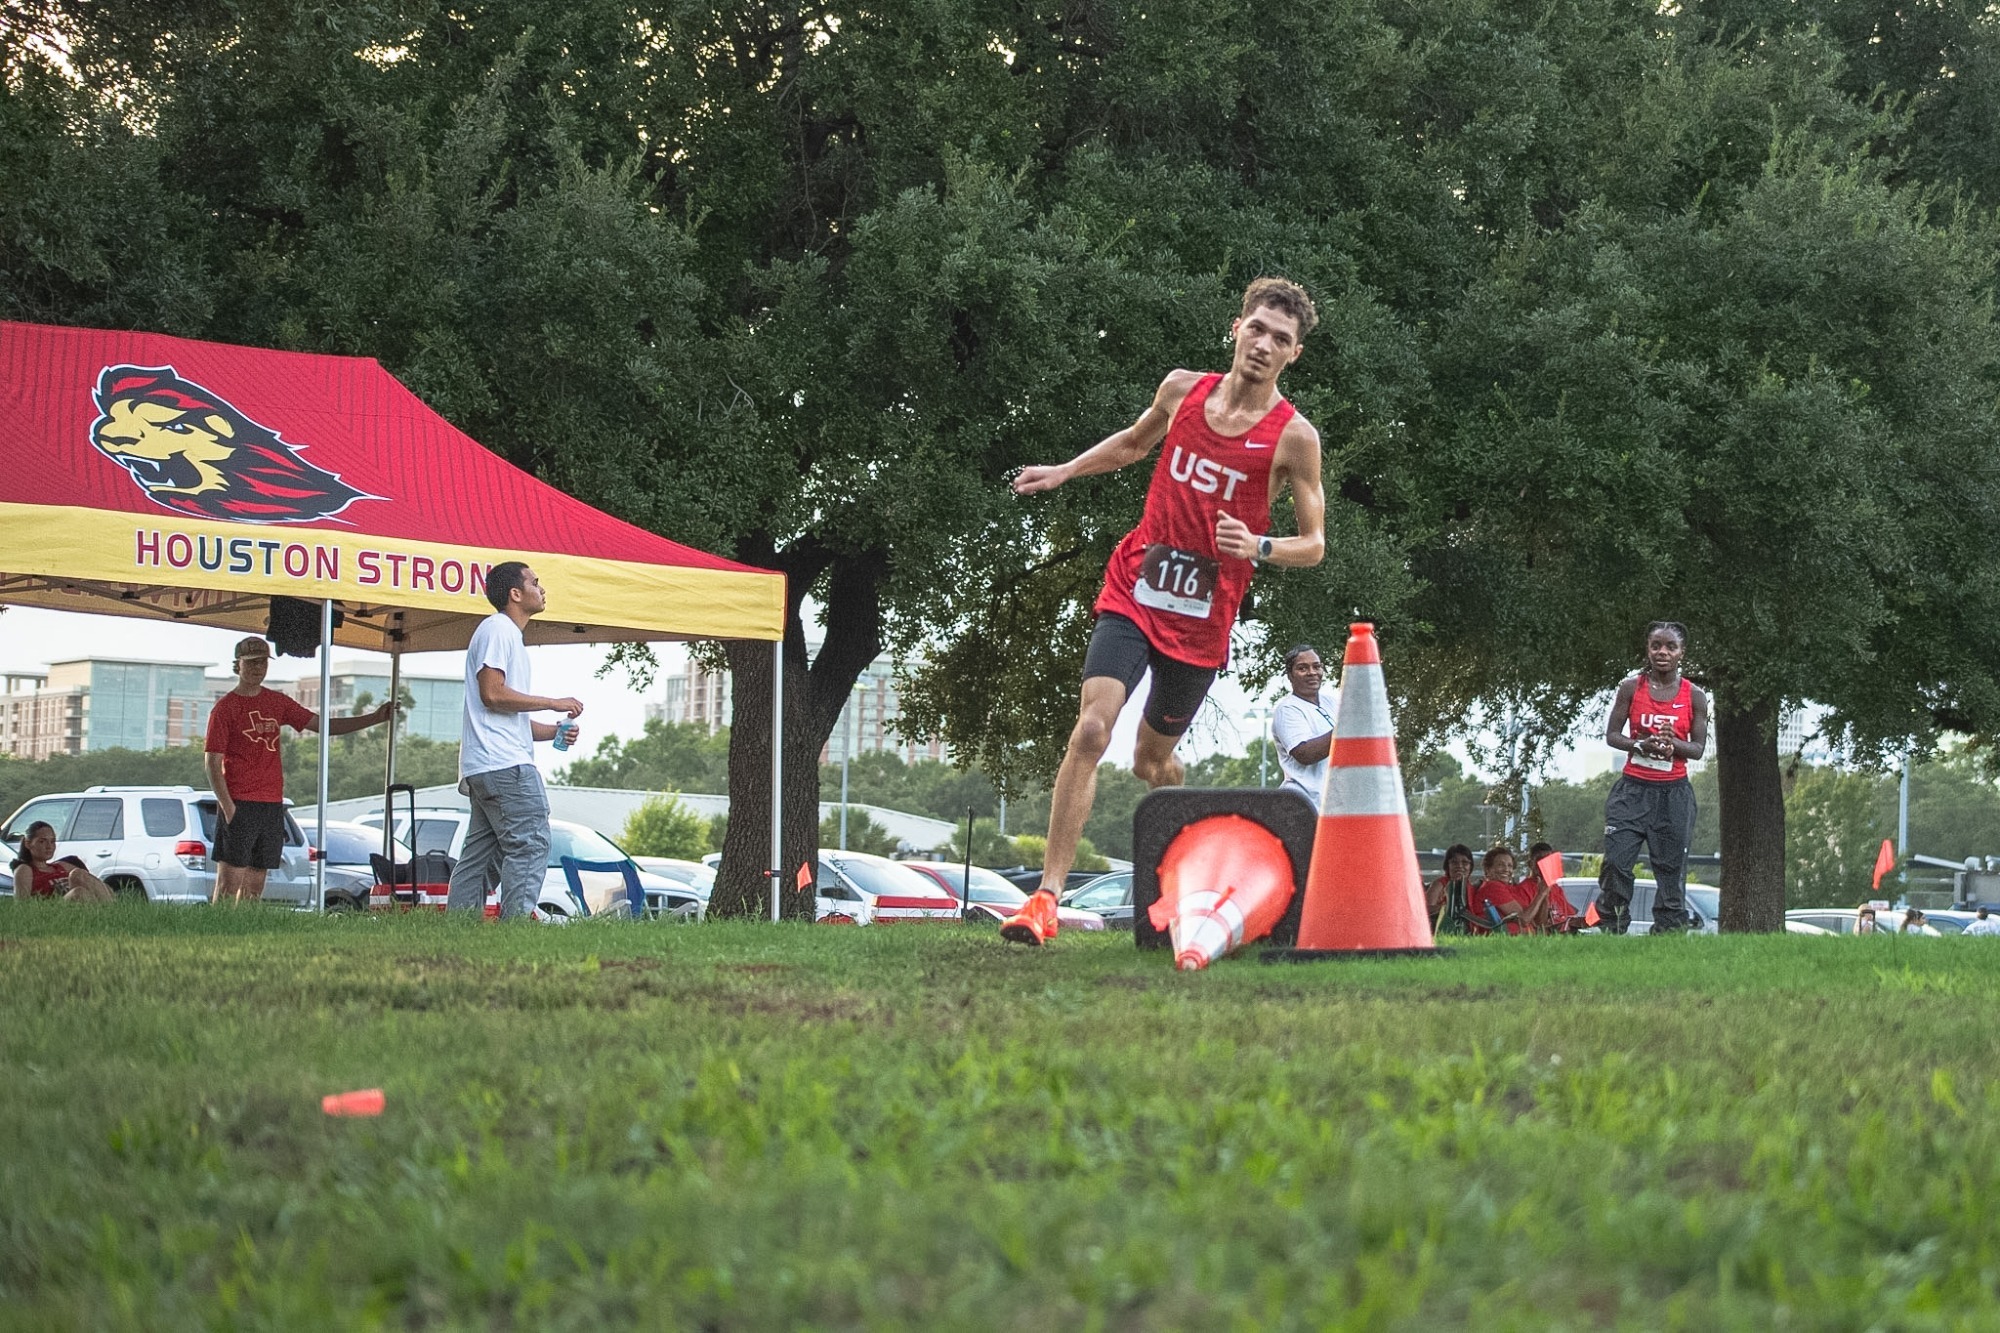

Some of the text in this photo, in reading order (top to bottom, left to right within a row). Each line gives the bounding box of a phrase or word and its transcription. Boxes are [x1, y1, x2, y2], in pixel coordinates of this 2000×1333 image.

[1169, 445, 1248, 502] UST
[136, 529, 493, 596] HOUSTON STRON
[1158, 560, 1199, 596] 116
